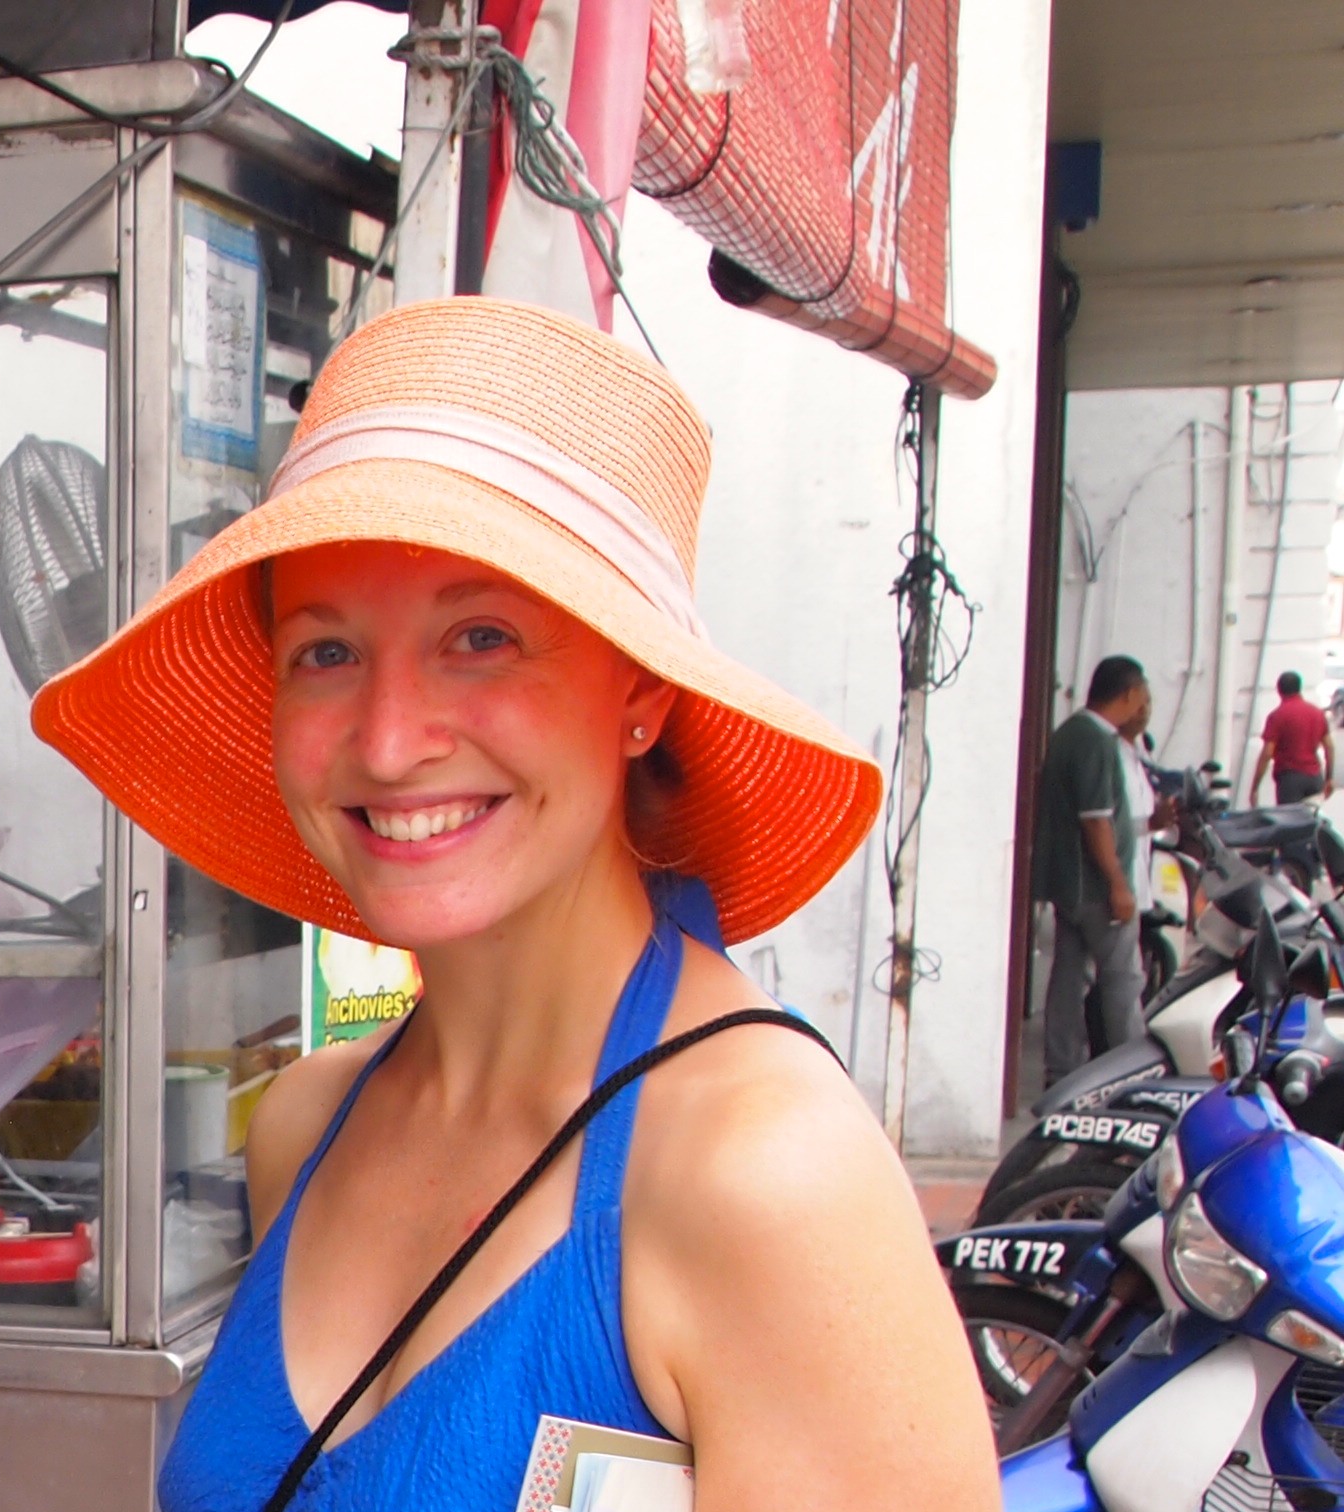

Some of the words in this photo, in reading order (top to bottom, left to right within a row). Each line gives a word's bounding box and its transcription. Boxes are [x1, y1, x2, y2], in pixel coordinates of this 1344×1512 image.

[324, 984, 404, 1028] Anchovies
[954, 1236, 1011, 1270] PEK
[1013, 1239, 1066, 1275] 772
